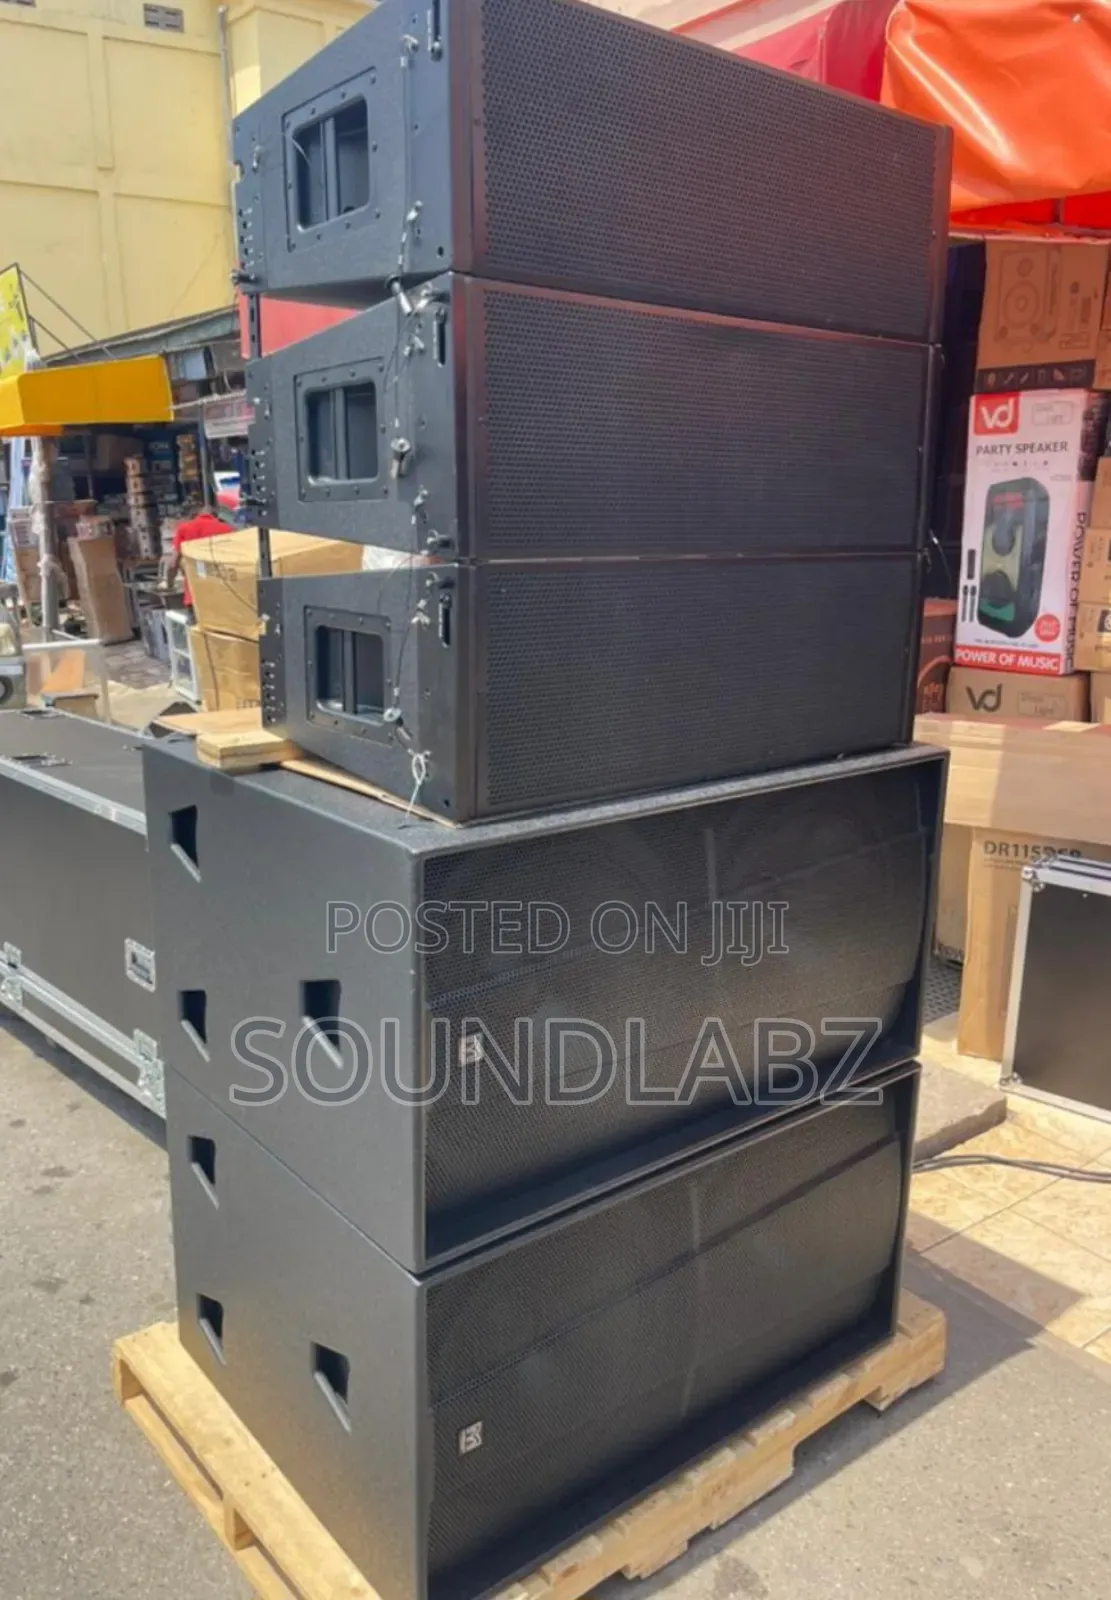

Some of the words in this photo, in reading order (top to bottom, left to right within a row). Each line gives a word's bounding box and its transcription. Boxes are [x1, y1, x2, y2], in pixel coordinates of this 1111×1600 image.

[975, 444, 1012, 455] PARTY
[1014, 441, 1068, 453] SPEAKER
[1070, 512, 1087, 581] POWER
[956, 649, 996, 664] POWER
[998, 653, 1015, 667] OF
[1016, 655, 1059, 671] MUSIC
